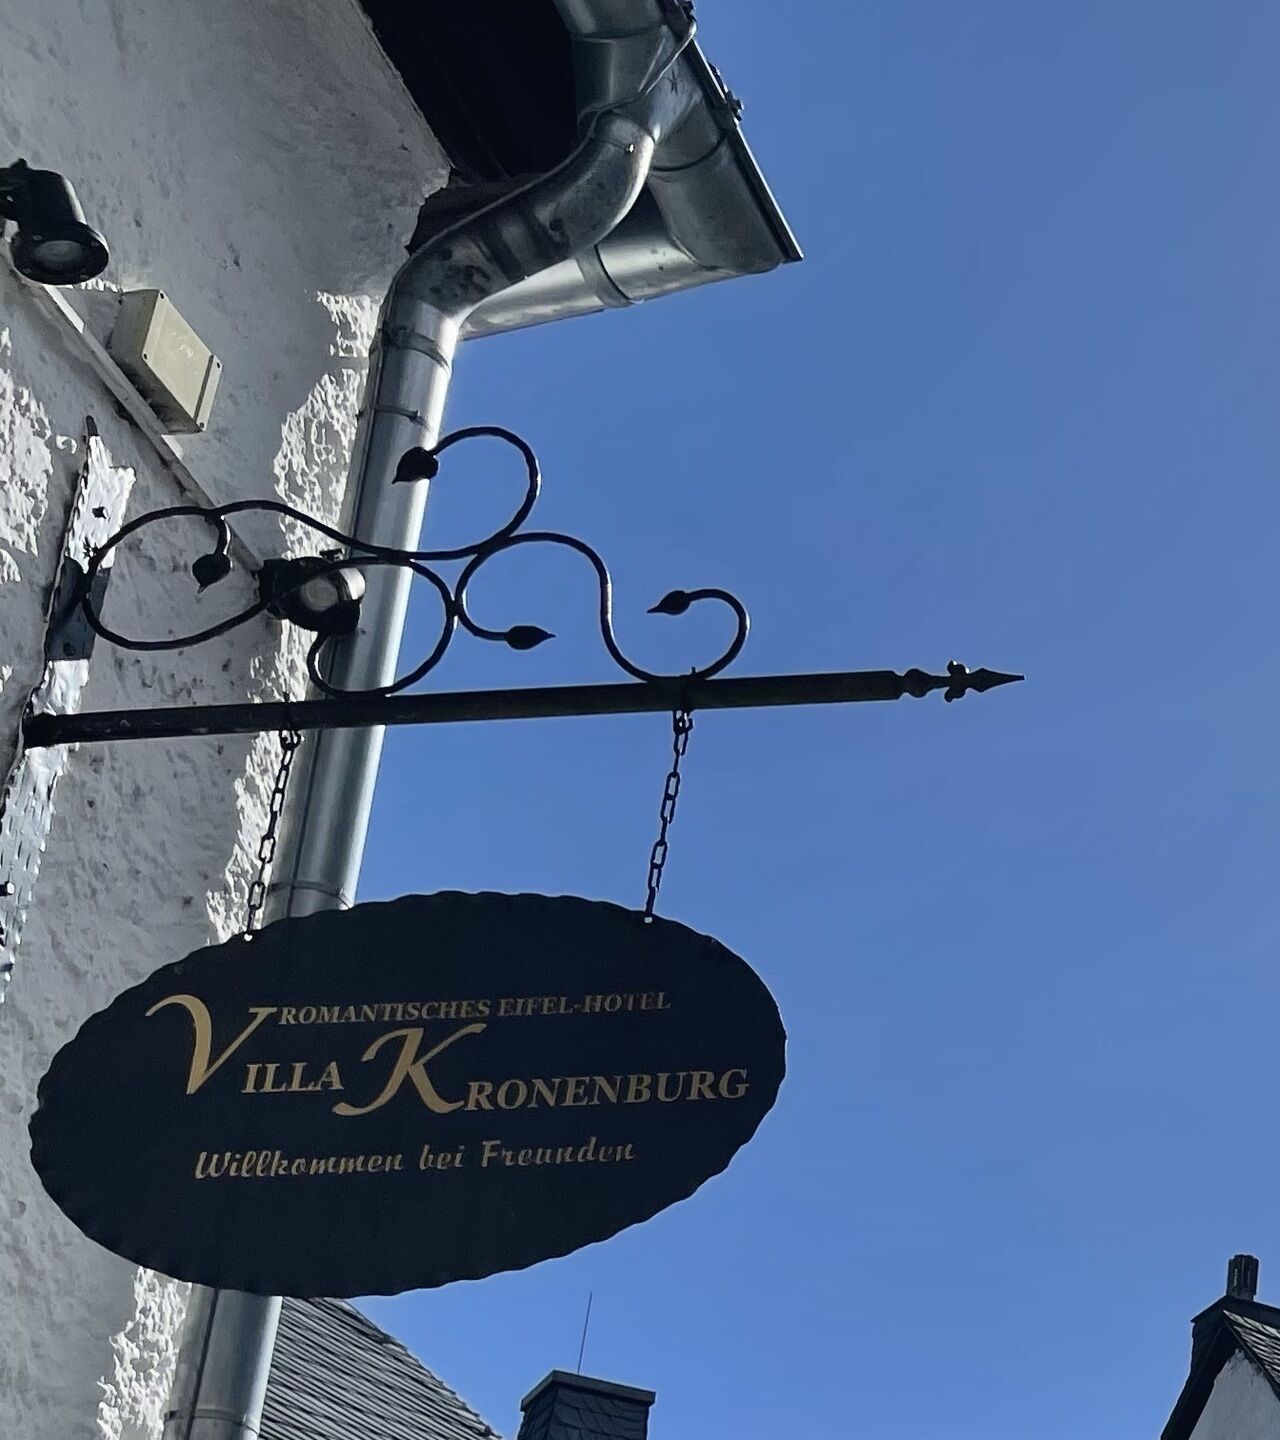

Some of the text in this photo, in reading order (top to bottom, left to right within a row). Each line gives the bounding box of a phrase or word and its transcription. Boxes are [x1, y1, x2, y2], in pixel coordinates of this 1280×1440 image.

[279, 991, 671, 1025] ROMANTISCHES EIFEL-HOTEL
[145, 994, 750, 1117] VILLA KRONENBURG
[194, 1136, 637, 1179] Willkommen bei Freunden
